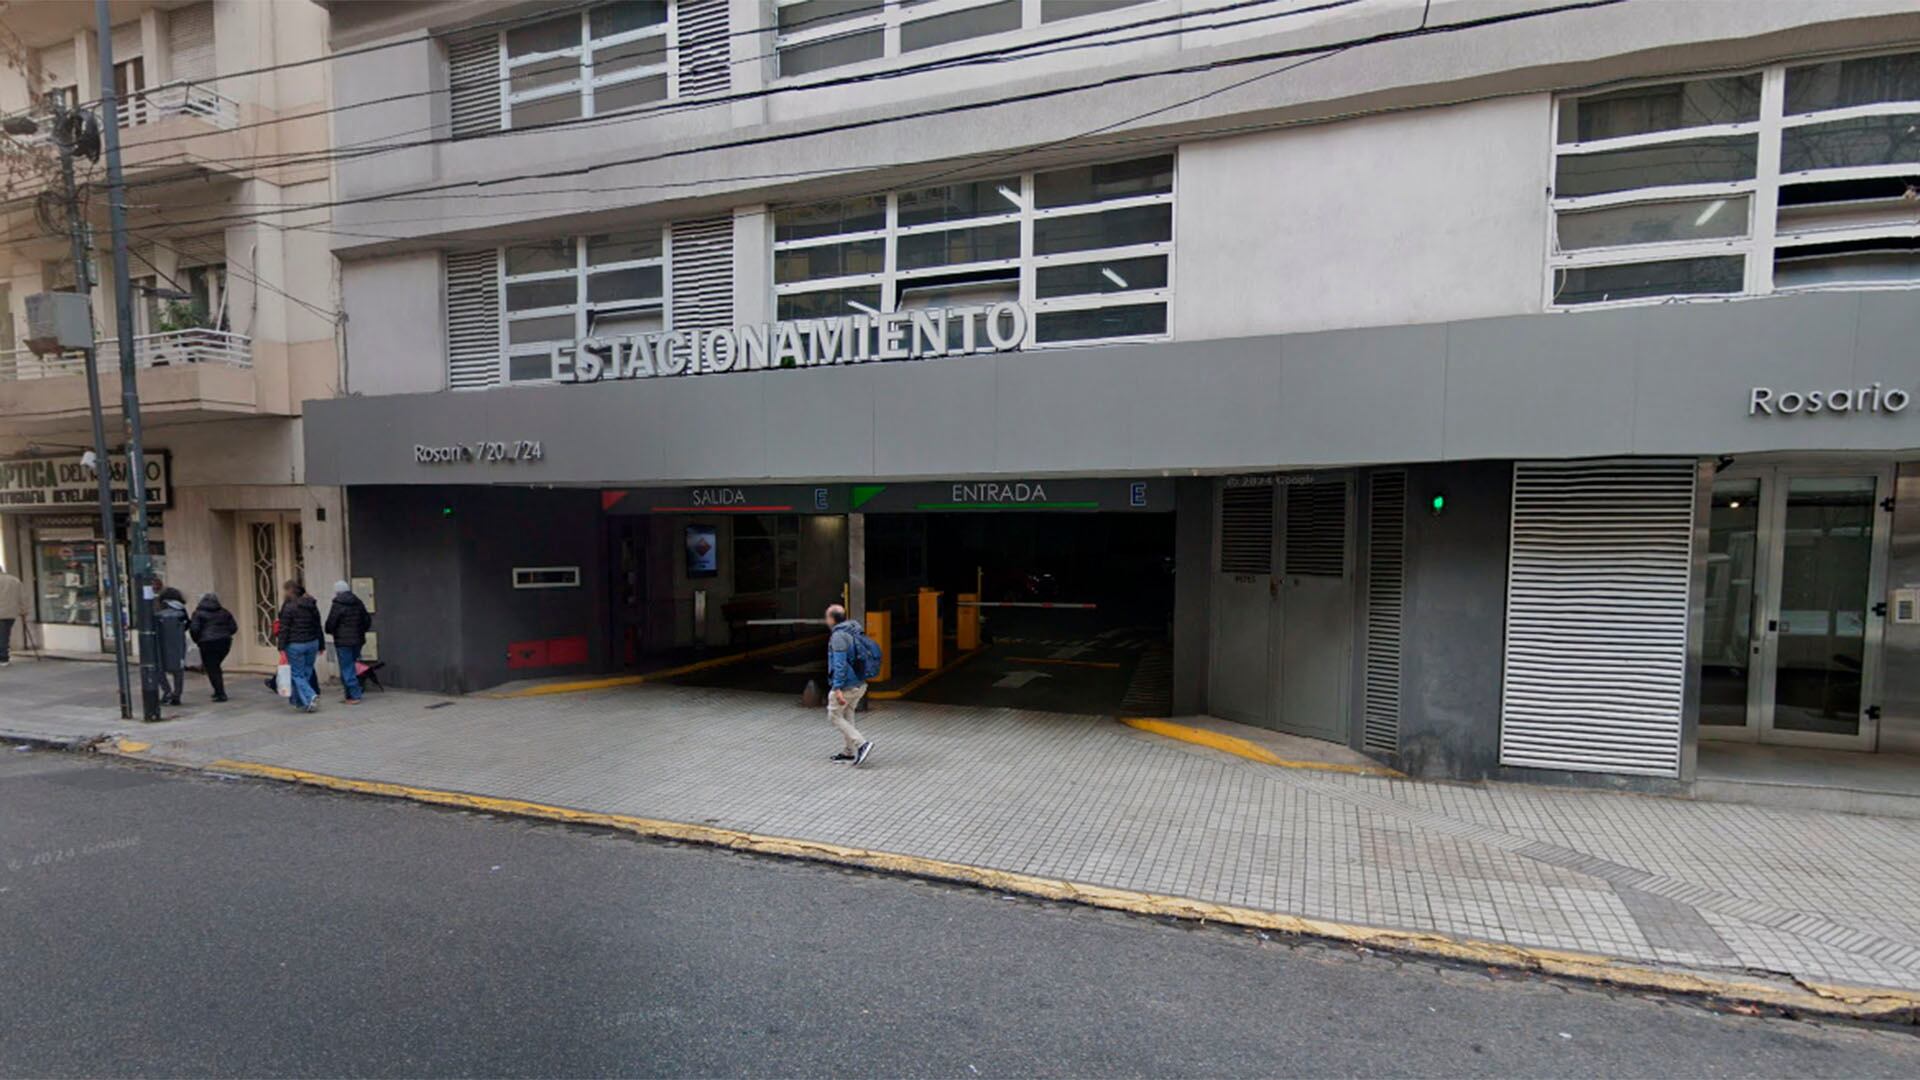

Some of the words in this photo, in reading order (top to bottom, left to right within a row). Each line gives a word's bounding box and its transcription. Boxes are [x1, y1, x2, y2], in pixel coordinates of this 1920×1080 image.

[550, 301, 1026, 382] ESTACIONAMIENTO
[1749, 382, 1909, 415] Rosario
[0, 461, 58, 488] PTICA
[692, 488, 746, 505] SALIDA
[814, 488, 829, 510] E
[952, 483, 1047, 502] ENTRADA
[1130, 482, 1147, 507] E
